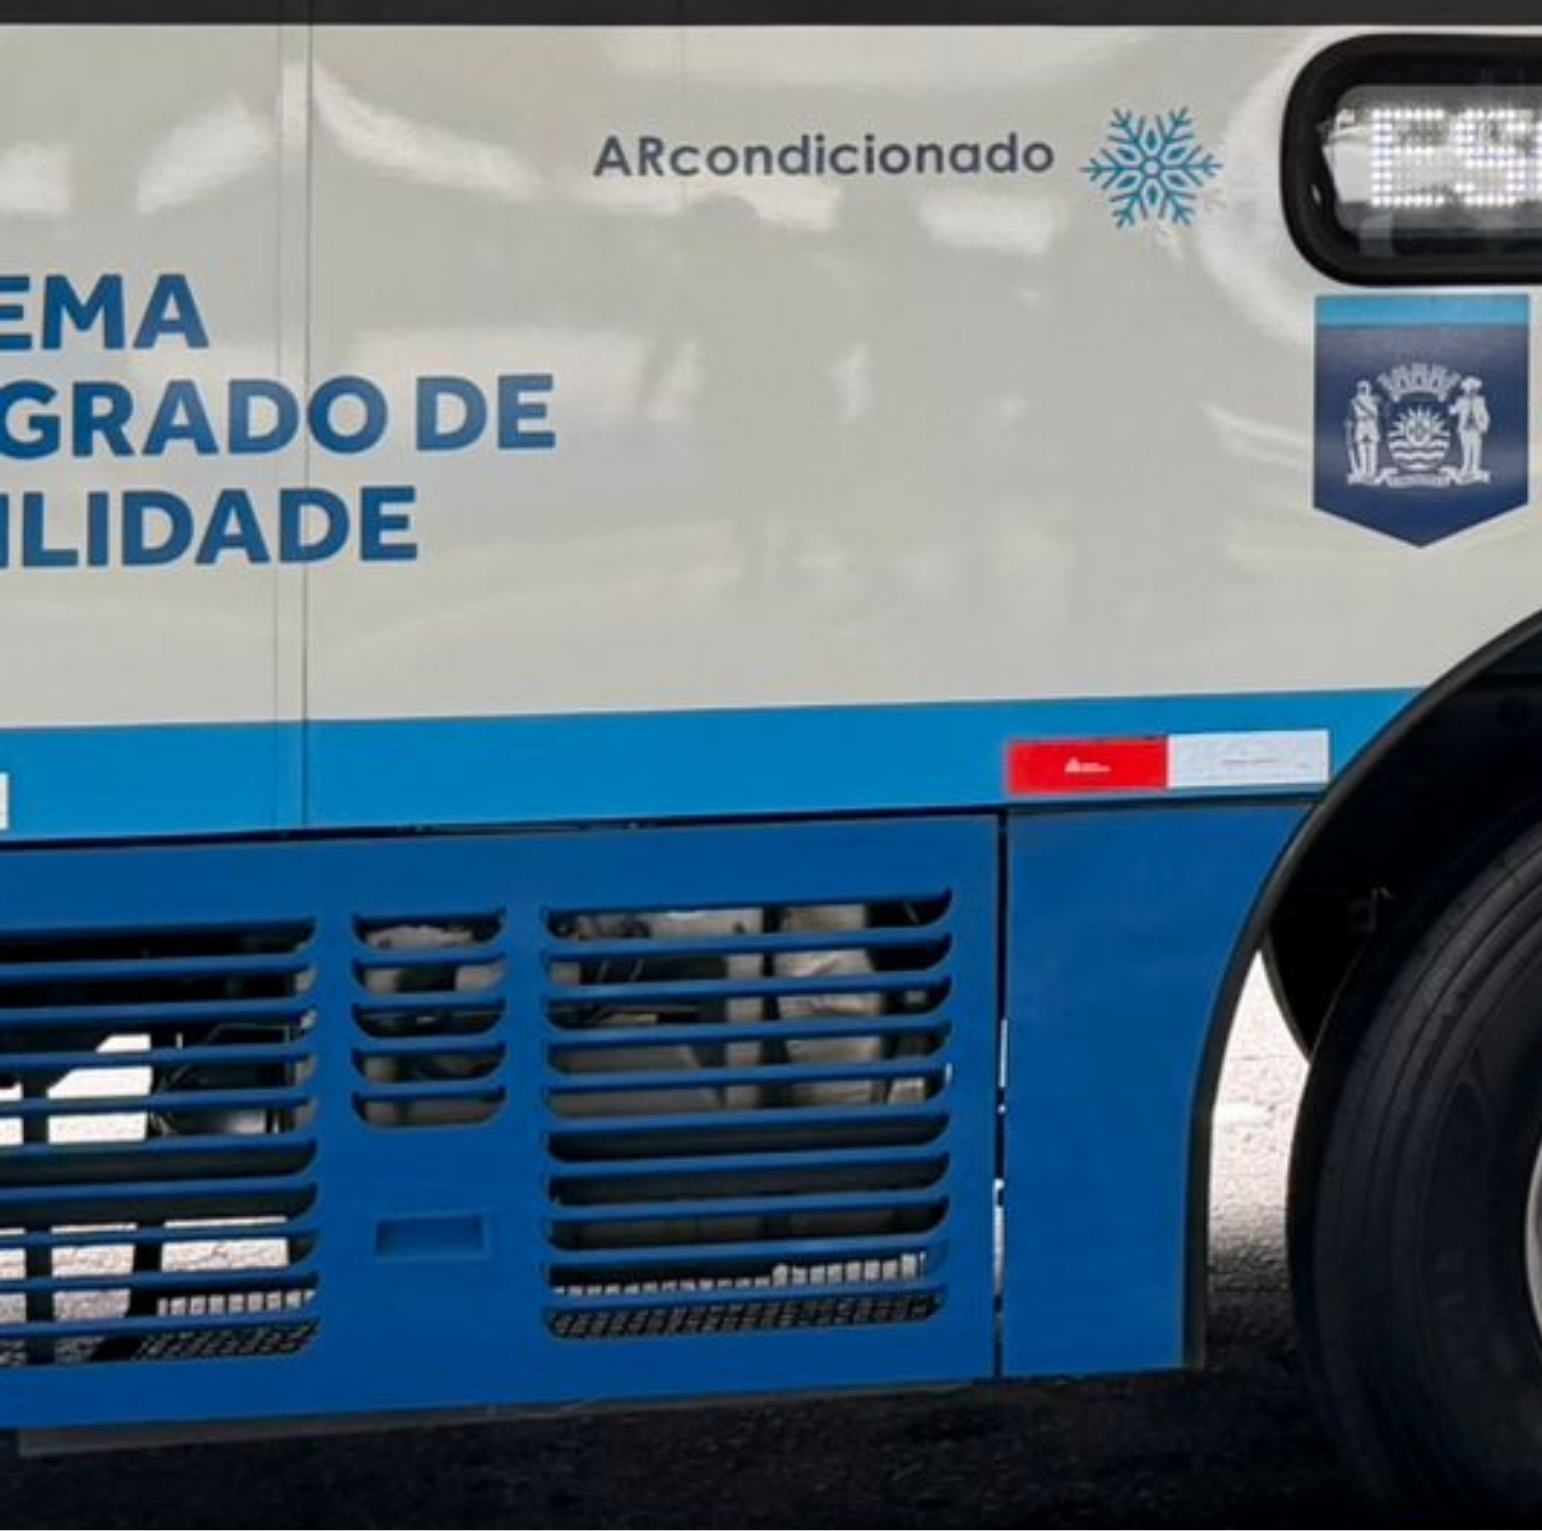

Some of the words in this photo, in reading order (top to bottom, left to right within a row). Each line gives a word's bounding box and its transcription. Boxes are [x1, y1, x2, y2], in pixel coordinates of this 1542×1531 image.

[593, 132, 1056, 179] ARcondicionado
[0, 375, 390, 460] GRADO
[416, 373, 557, 452] DE
